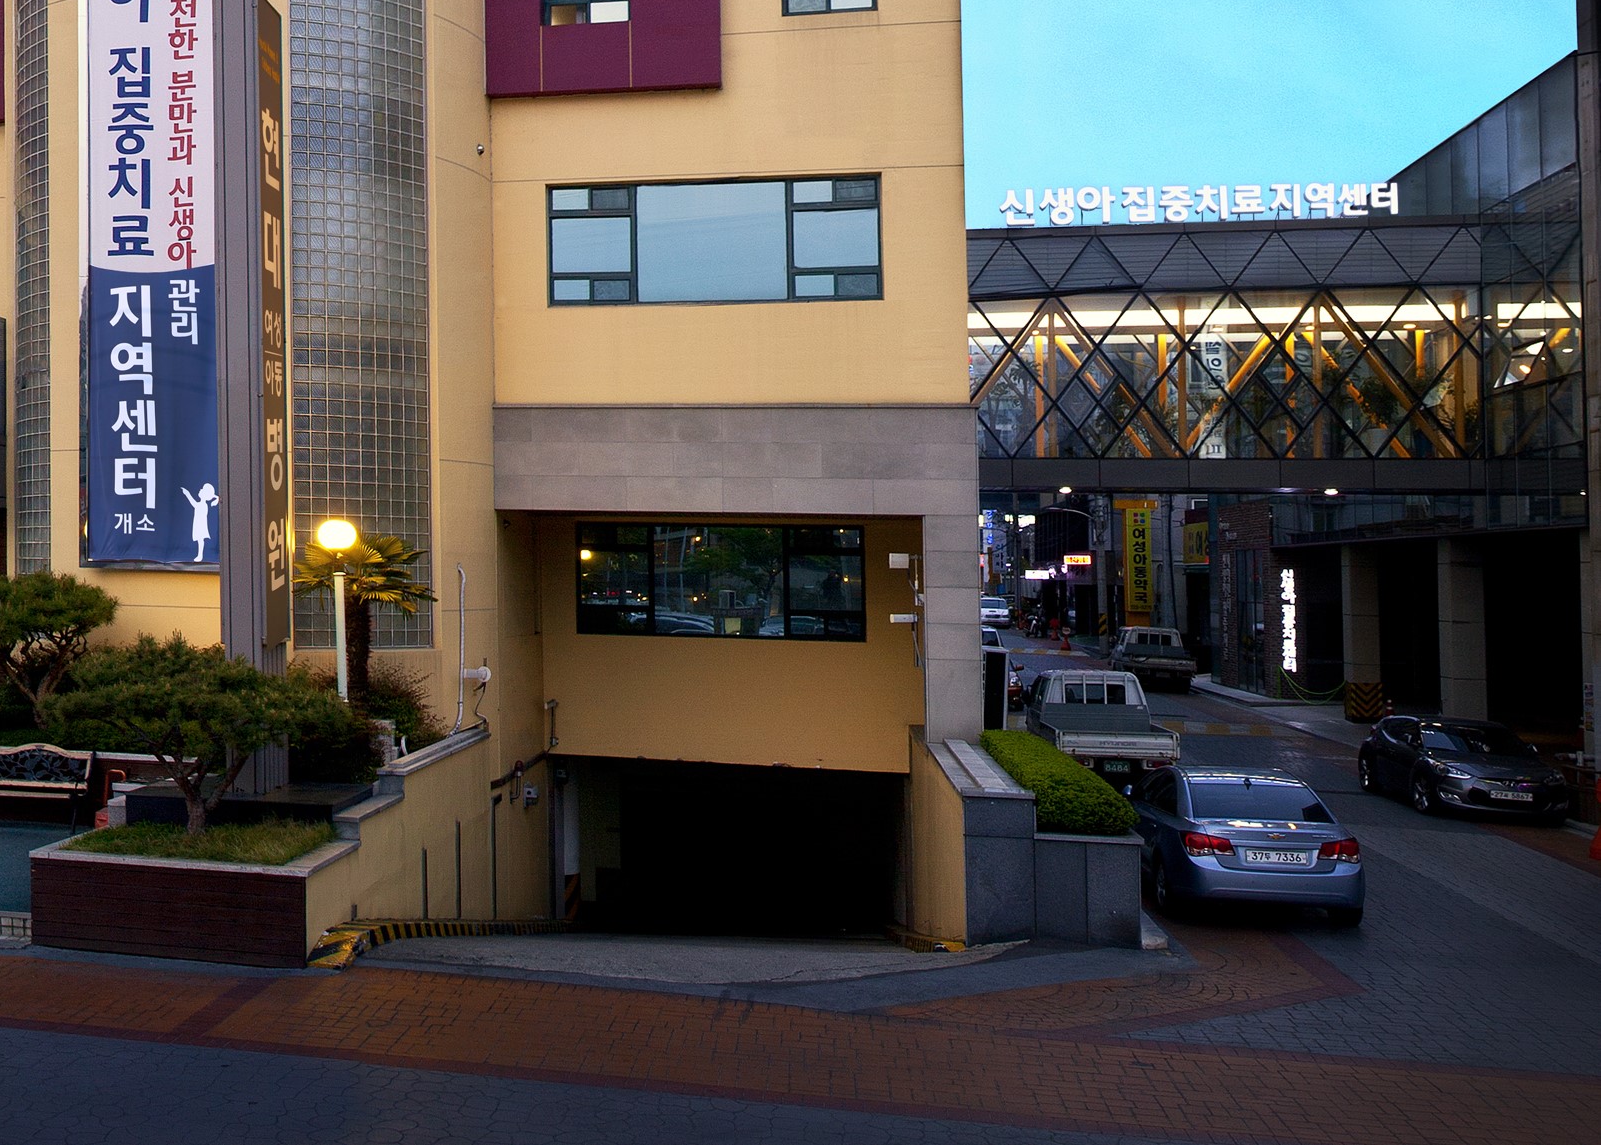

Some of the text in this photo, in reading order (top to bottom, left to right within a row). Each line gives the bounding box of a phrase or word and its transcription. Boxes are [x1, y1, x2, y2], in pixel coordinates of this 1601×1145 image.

[106, 46, 155, 257] 집중치료
[166, 69, 198, 167] 분만과
[166, 176, 197, 270] 신생아
[260, 108, 282, 290] 현대
[168, 279, 200, 345] 관리
[263, 309, 283, 350] 여성
[109, 284, 158, 510] 지역센터
[264, 358, 283, 398] 아동
[113, 512, 156, 535] 개소
[265, 417, 286, 593] 병원
[1132, 527, 1149, 604] 여성아동약국
[1105, 764, 1129, 773] 8484
[1275, 852, 1302, 863] 7336
